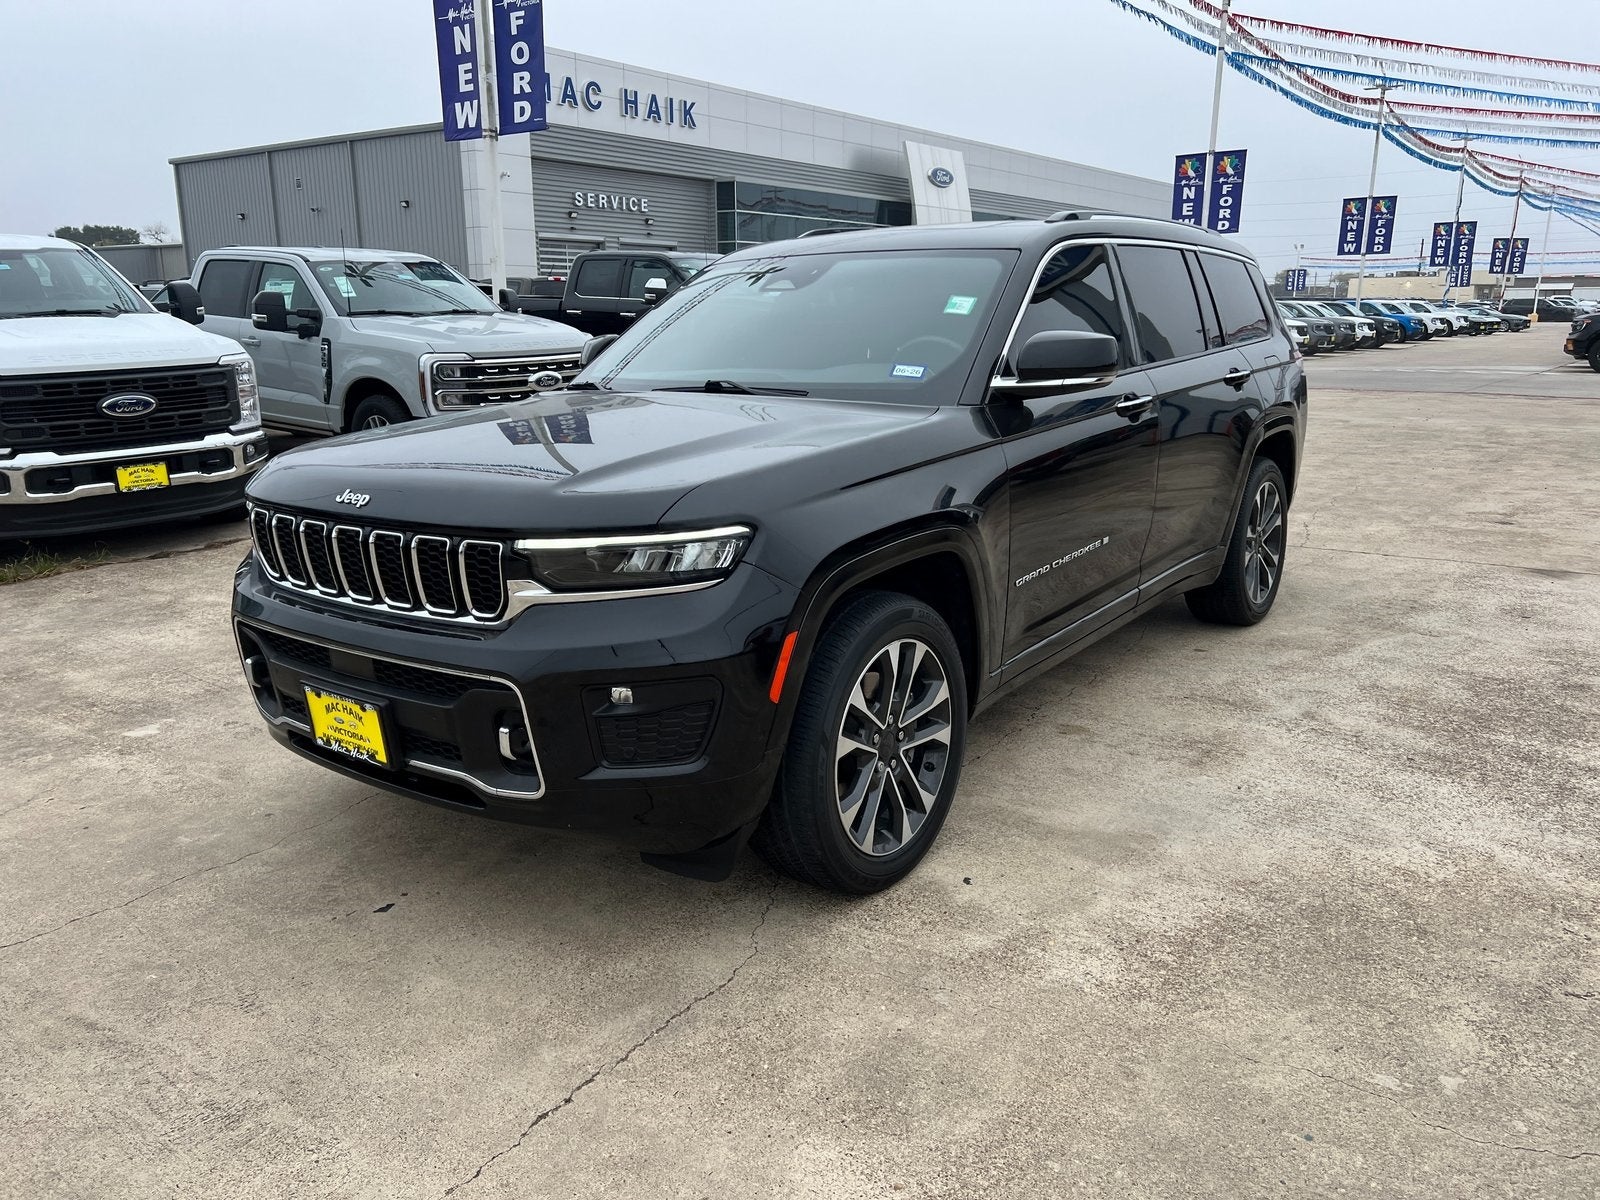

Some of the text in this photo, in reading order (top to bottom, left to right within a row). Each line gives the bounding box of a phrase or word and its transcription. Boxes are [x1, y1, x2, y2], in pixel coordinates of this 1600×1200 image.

[453, 24, 478, 129] NEW
[510, 11, 532, 123] FORD
[621, 87, 697, 129] HAIK
[936, 170, 951, 182] Ford
[575, 191, 649, 212] SERVICE
[1217, 184, 1233, 230] FORD
[1343, 220, 1358, 253] NEW
[1373, 219, 1386, 252] FORD
[1434, 239, 1445, 264] NEW
[1458, 239, 1468, 264] FORD
[1493, 252, 1503, 272] NEW
[1513, 252, 1521, 272] FORD
[115, 399, 144, 412] Ford
[335, 488, 371, 508] Jeep
[1015, 539, 1101, 587] GRAND CHEROKEE
[325, 702, 341, 715] MAC
[342, 704, 365, 726] HAIK
[333, 725, 366, 741] VICTORIA
[328, 741, 350, 755] Mac
